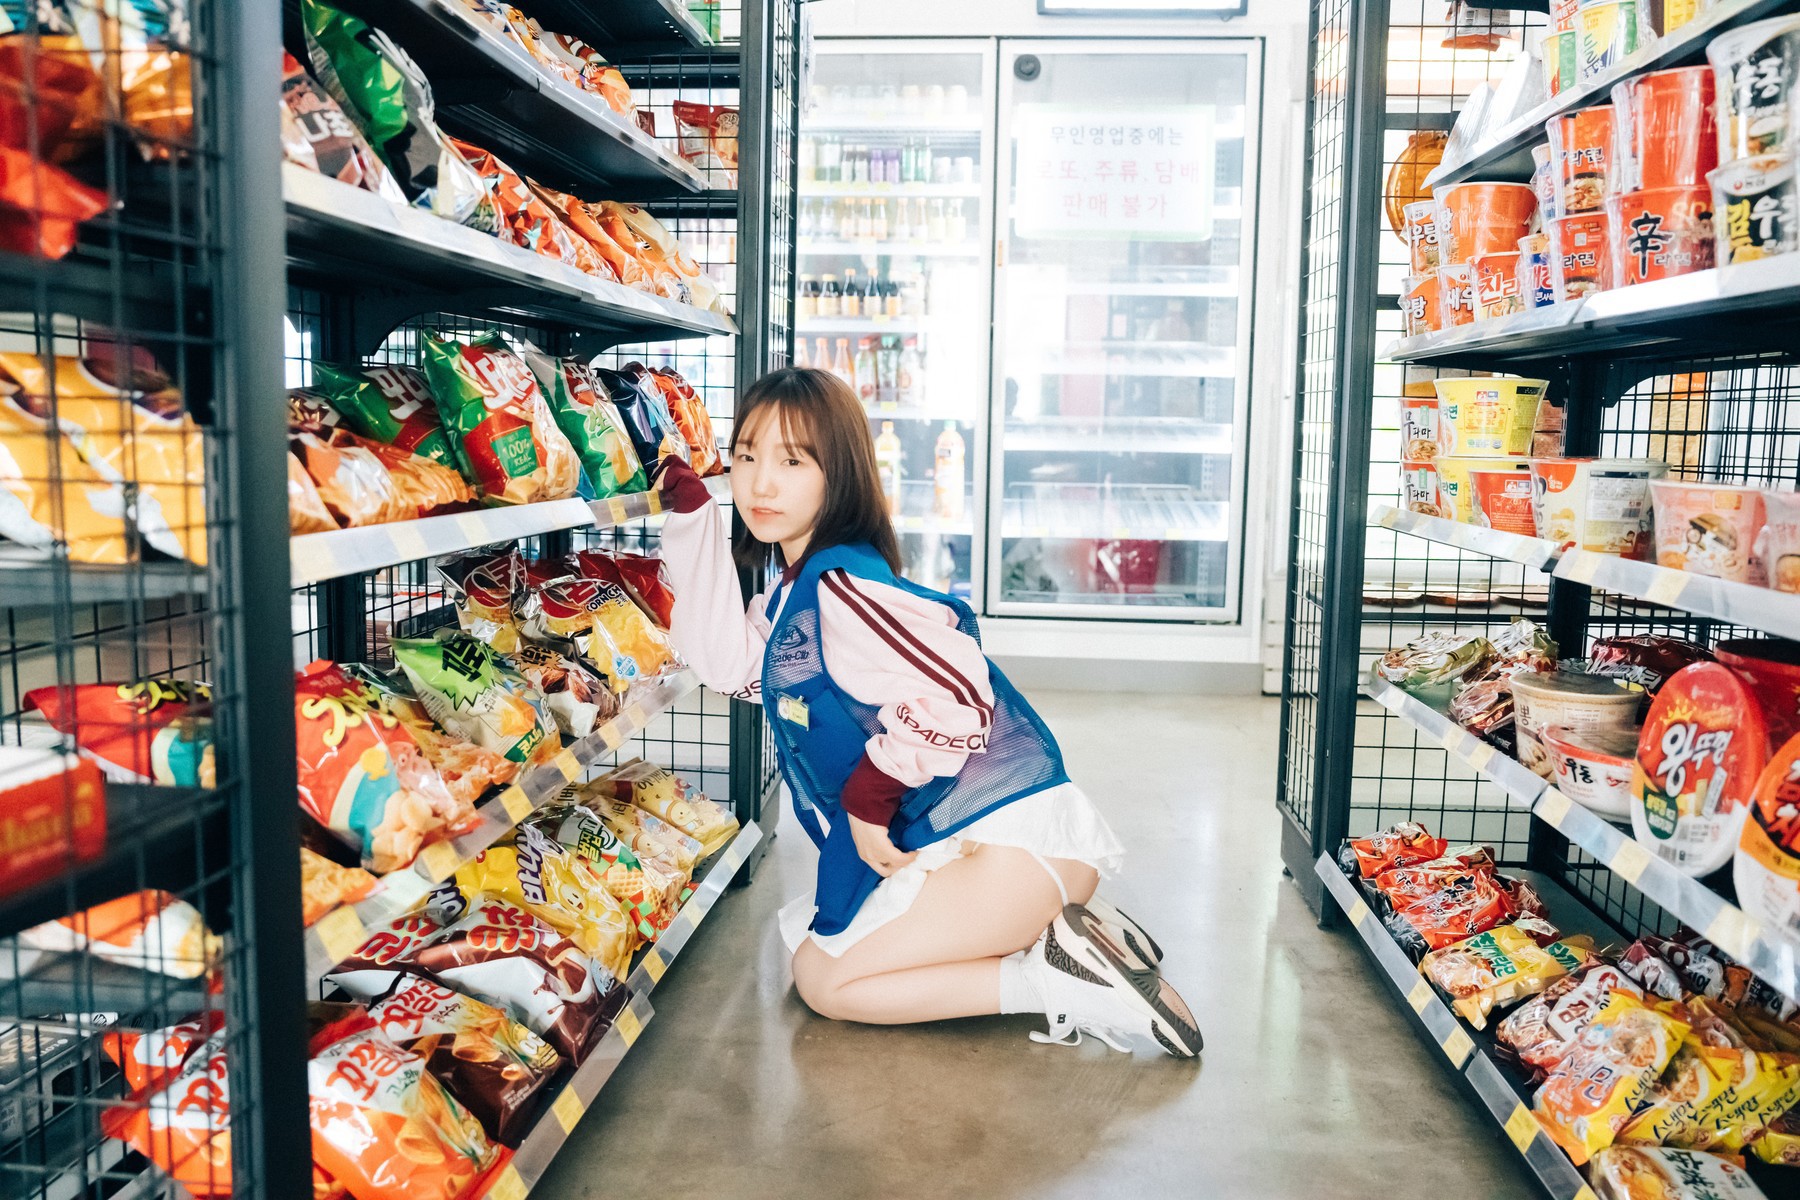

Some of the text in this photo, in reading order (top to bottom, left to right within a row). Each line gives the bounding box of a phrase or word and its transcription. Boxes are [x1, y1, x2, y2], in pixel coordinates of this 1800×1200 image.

[1051, 126, 1184, 146] 무인영업중에는
[1062, 193, 1167, 219] 판매 불가
[1627, 210, 1675, 279] 辛
[502, 437, 531, 458] 100%
[1563, 757, 1595, 784] 우동
